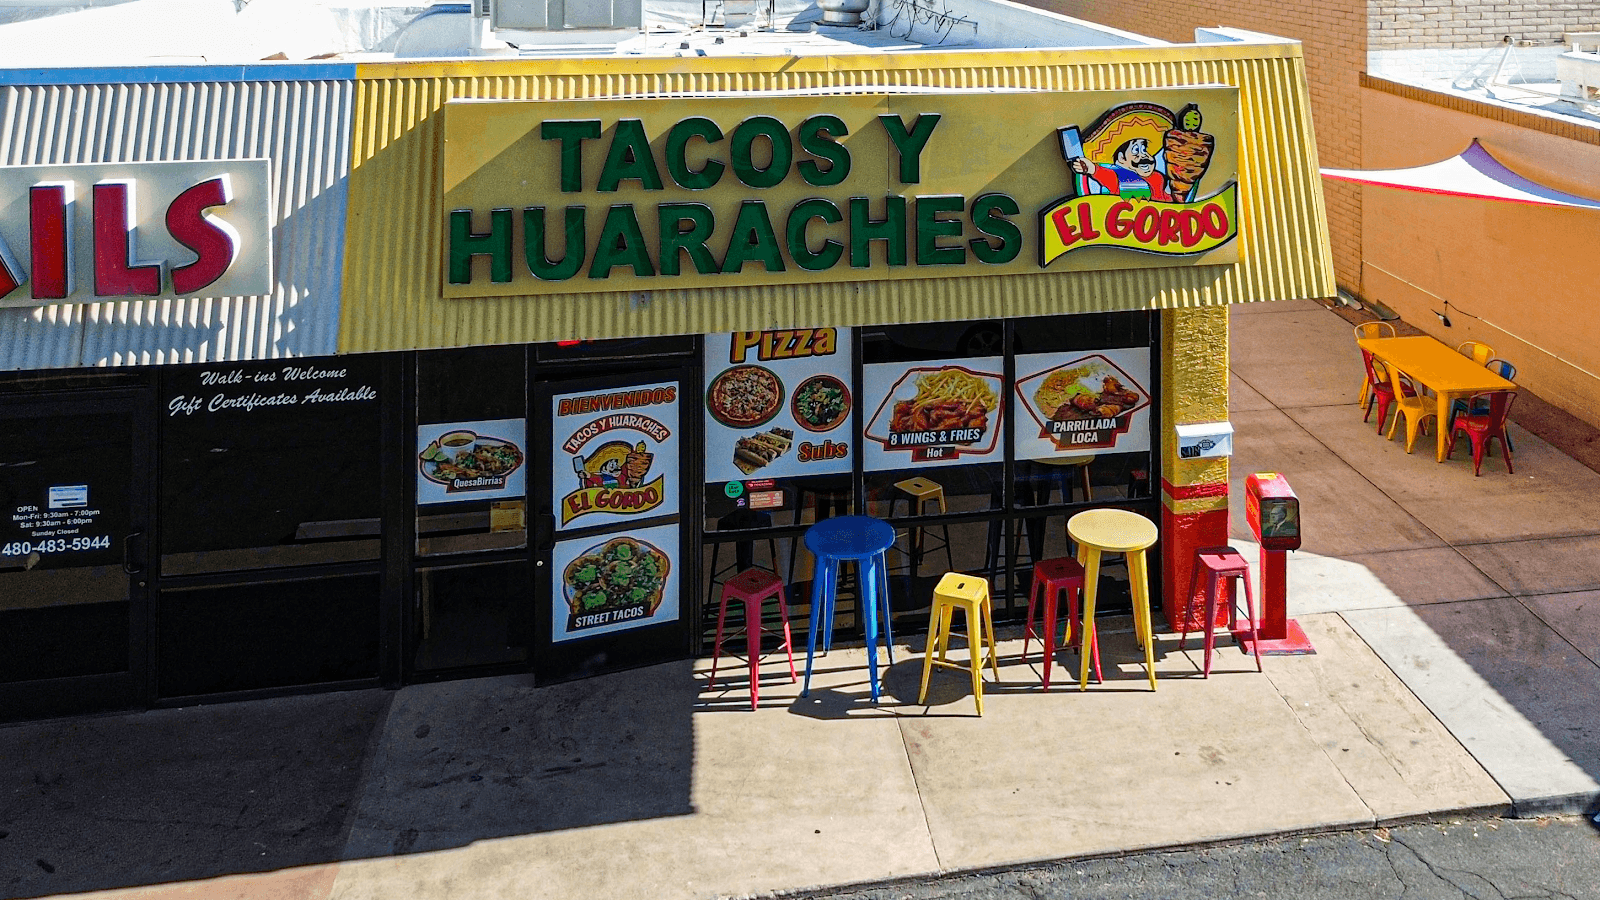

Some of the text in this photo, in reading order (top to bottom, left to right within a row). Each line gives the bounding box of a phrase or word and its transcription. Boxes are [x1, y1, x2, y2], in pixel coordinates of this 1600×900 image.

[541, 111, 941, 193] TACOS Y
[1052, 201, 1229, 248] EL GORDO
[0, 172, 241, 300] ILS
[448, 192, 1023, 285] HUARACHES
[730, 327, 838, 364] Pizza
[200, 366, 347, 386] Walk-ins Welcome
[168, 385, 378, 416] Gift Certificates Available
[558, 386, 677, 416] BIENVENIDOS
[565, 415, 668, 451] TACOS Y HUARACHES
[890, 428, 981, 445] 8 WINGS & FRIES
[1053, 418, 1117, 433] PARRILLADA
[1071, 432, 1098, 444] LOCA
[798, 439, 849, 463] Subs
[926, 447, 943, 458] Hot
[454, 476, 503, 489] QuesaBirrias
[17, 505, 38, 513] OPEN
[567, 487, 659, 515] EL GORDO
[20, 521, 34, 529] Sat:
[67, 518, 92, 526] 6:00pm
[43, 511, 69, 519] 9:30am
[74, 509, 100, 517] 7:00pm
[31, 529, 56, 537] Sunday
[2, 535, 110, 556] 480-483-5944
[575, 605, 645, 628] STREET TACOS
